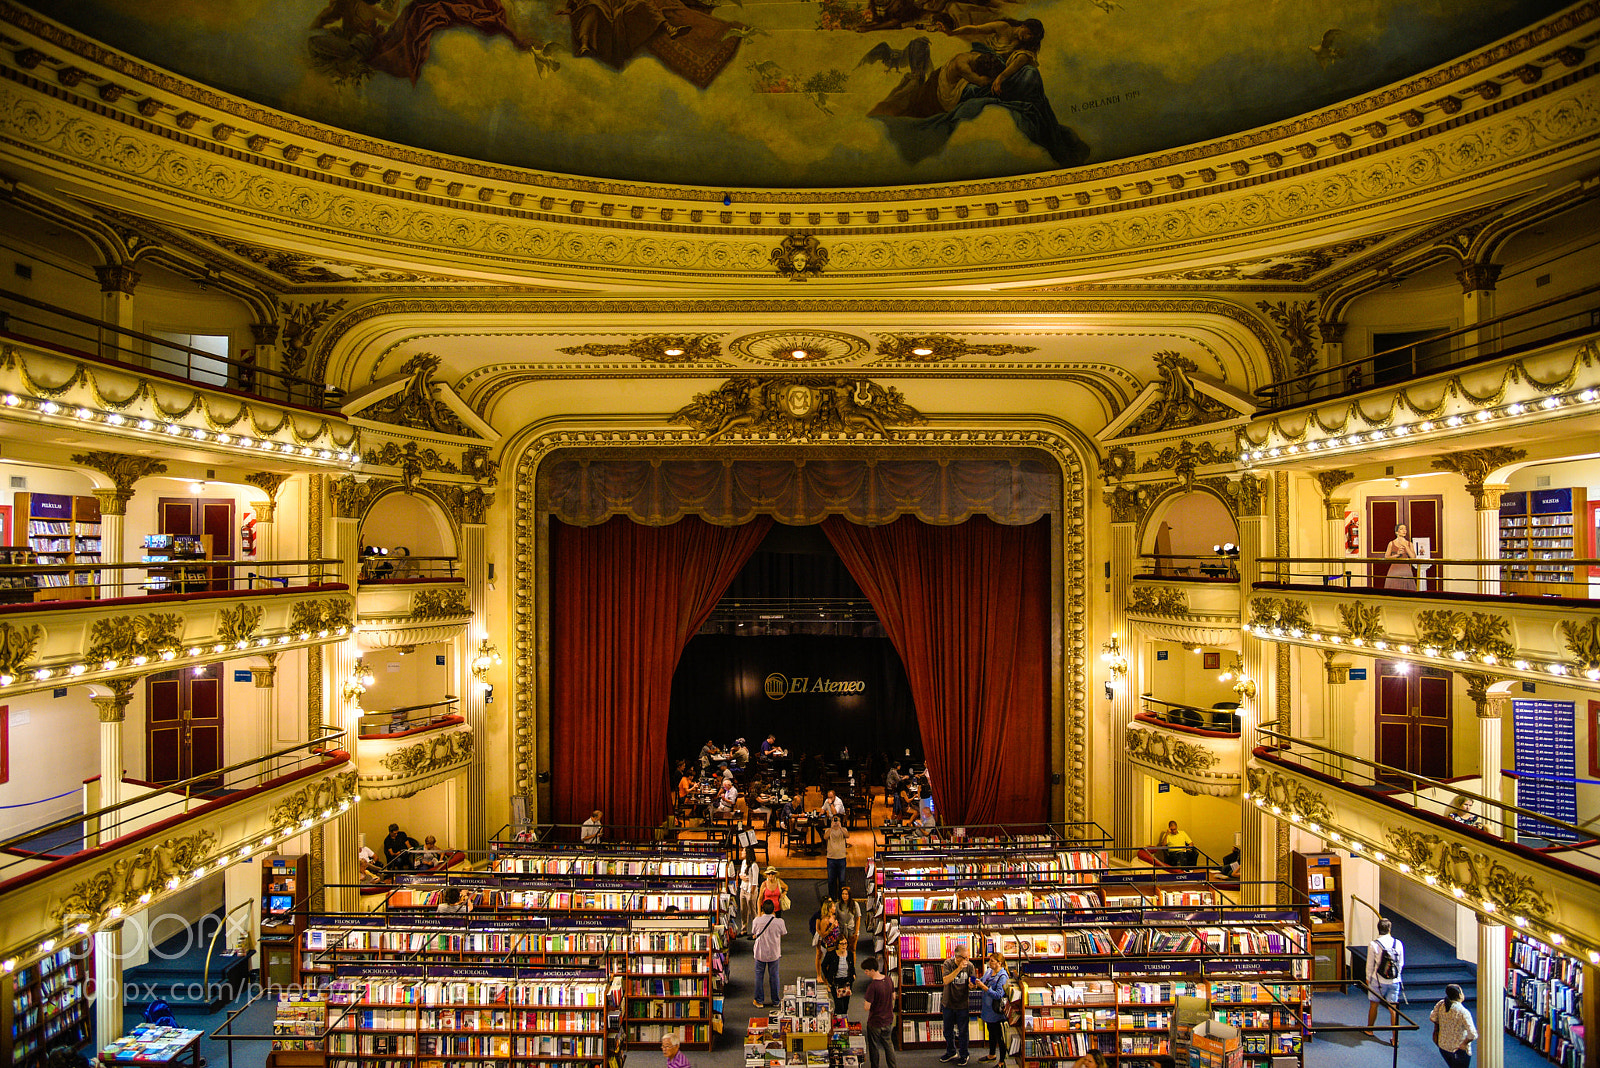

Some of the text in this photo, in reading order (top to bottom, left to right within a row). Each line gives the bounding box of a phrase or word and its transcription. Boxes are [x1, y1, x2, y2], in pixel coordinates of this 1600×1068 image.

[1081, 94, 1121, 110] ORLANDI
[788, 677, 866, 694] El Ateneo
